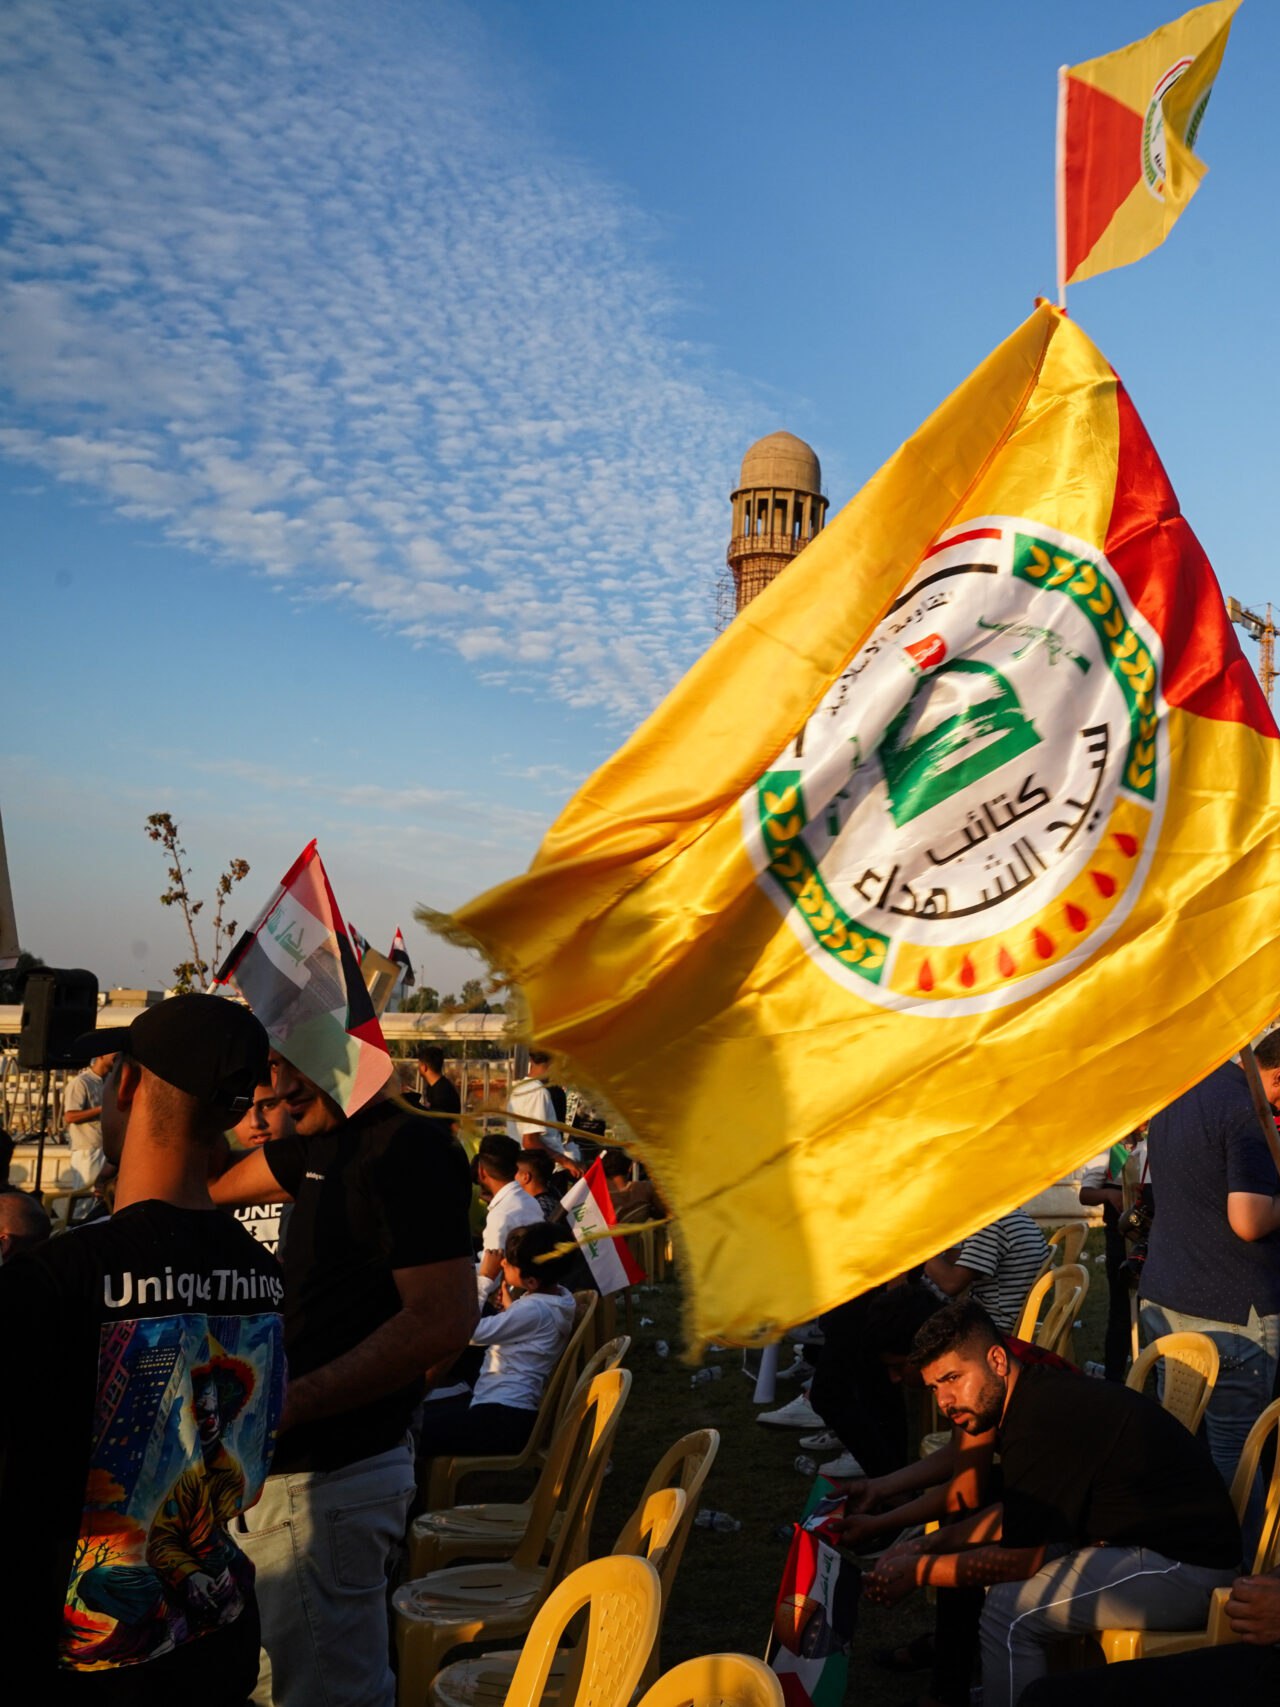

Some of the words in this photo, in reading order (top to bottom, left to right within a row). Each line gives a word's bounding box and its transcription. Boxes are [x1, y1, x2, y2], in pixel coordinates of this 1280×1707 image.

[926, 773, 1052, 866] كتائب
[1046, 722, 1110, 853] سيد
[853, 836, 1048, 920] الشهداء
